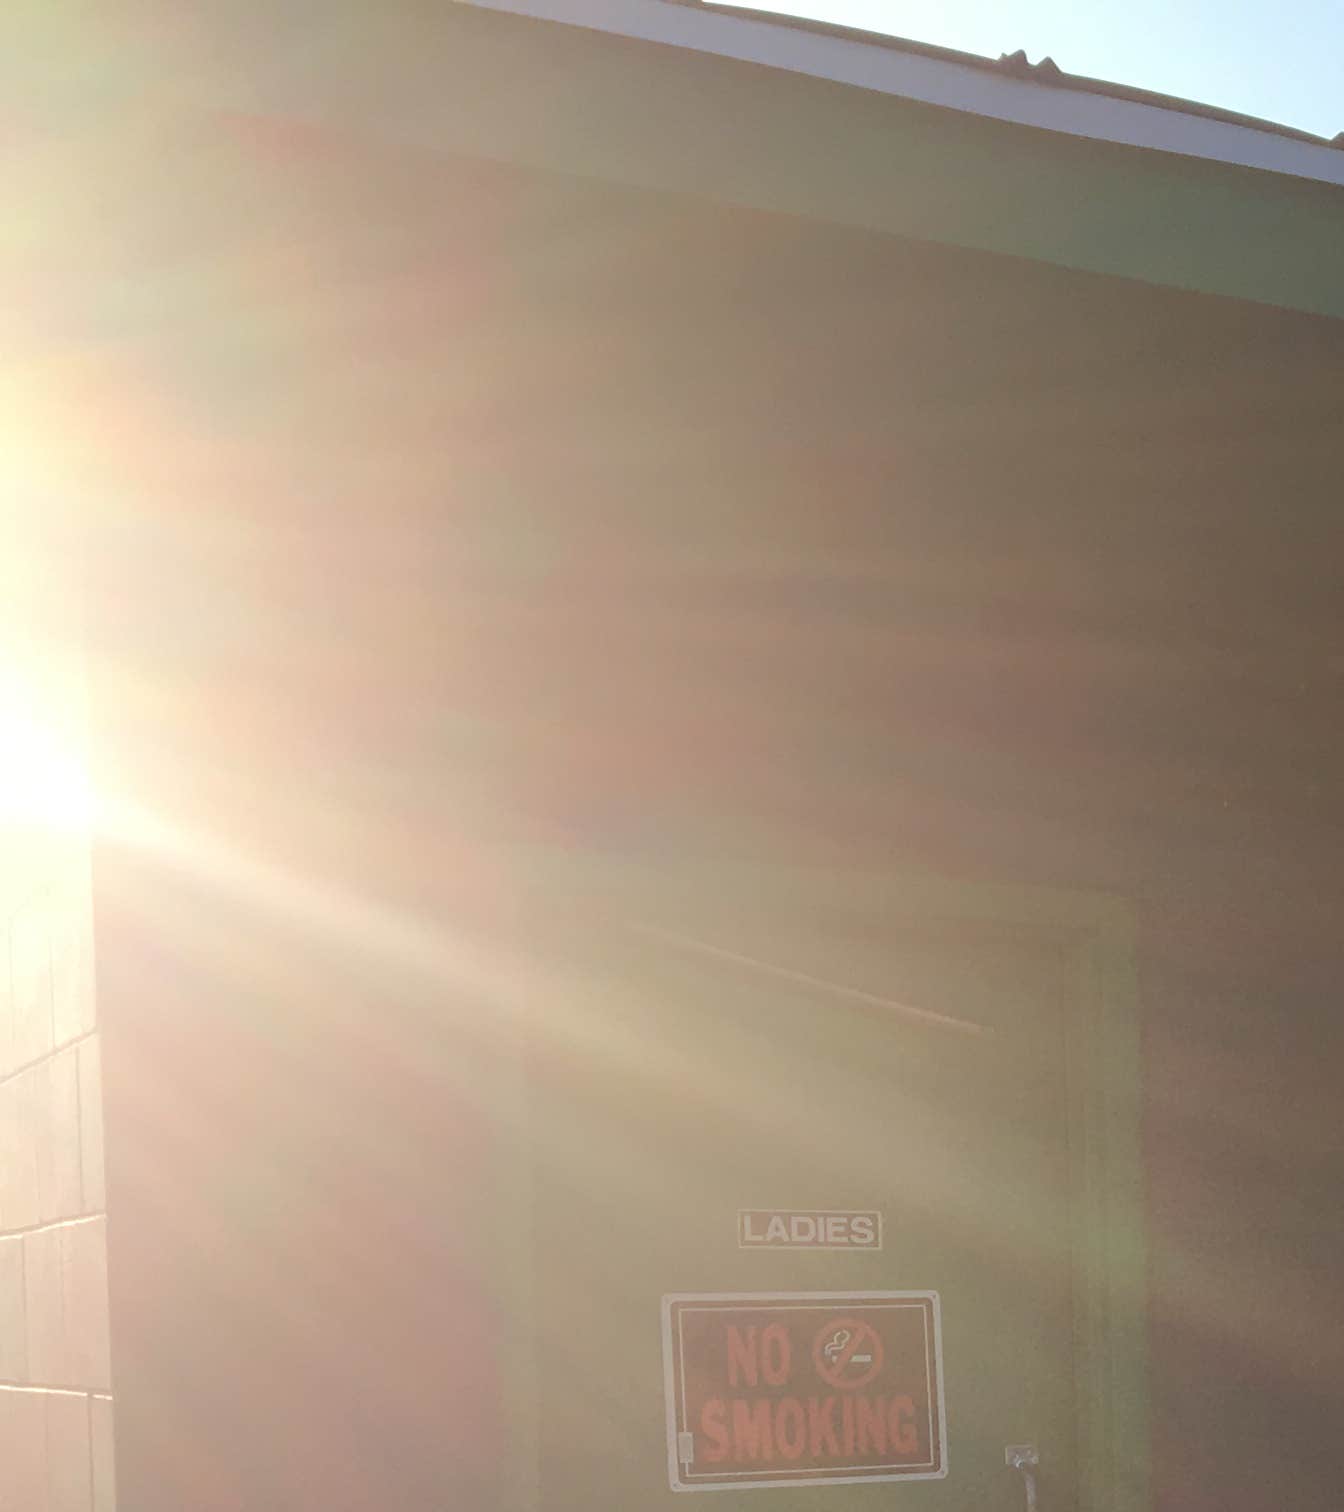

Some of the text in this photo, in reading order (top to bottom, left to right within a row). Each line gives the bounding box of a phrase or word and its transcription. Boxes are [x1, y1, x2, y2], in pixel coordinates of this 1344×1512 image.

[743, 1216, 875, 1244] LADIES
[726, 1323, 792, 1387] NO
[702, 1395, 917, 1462] SMOKING
